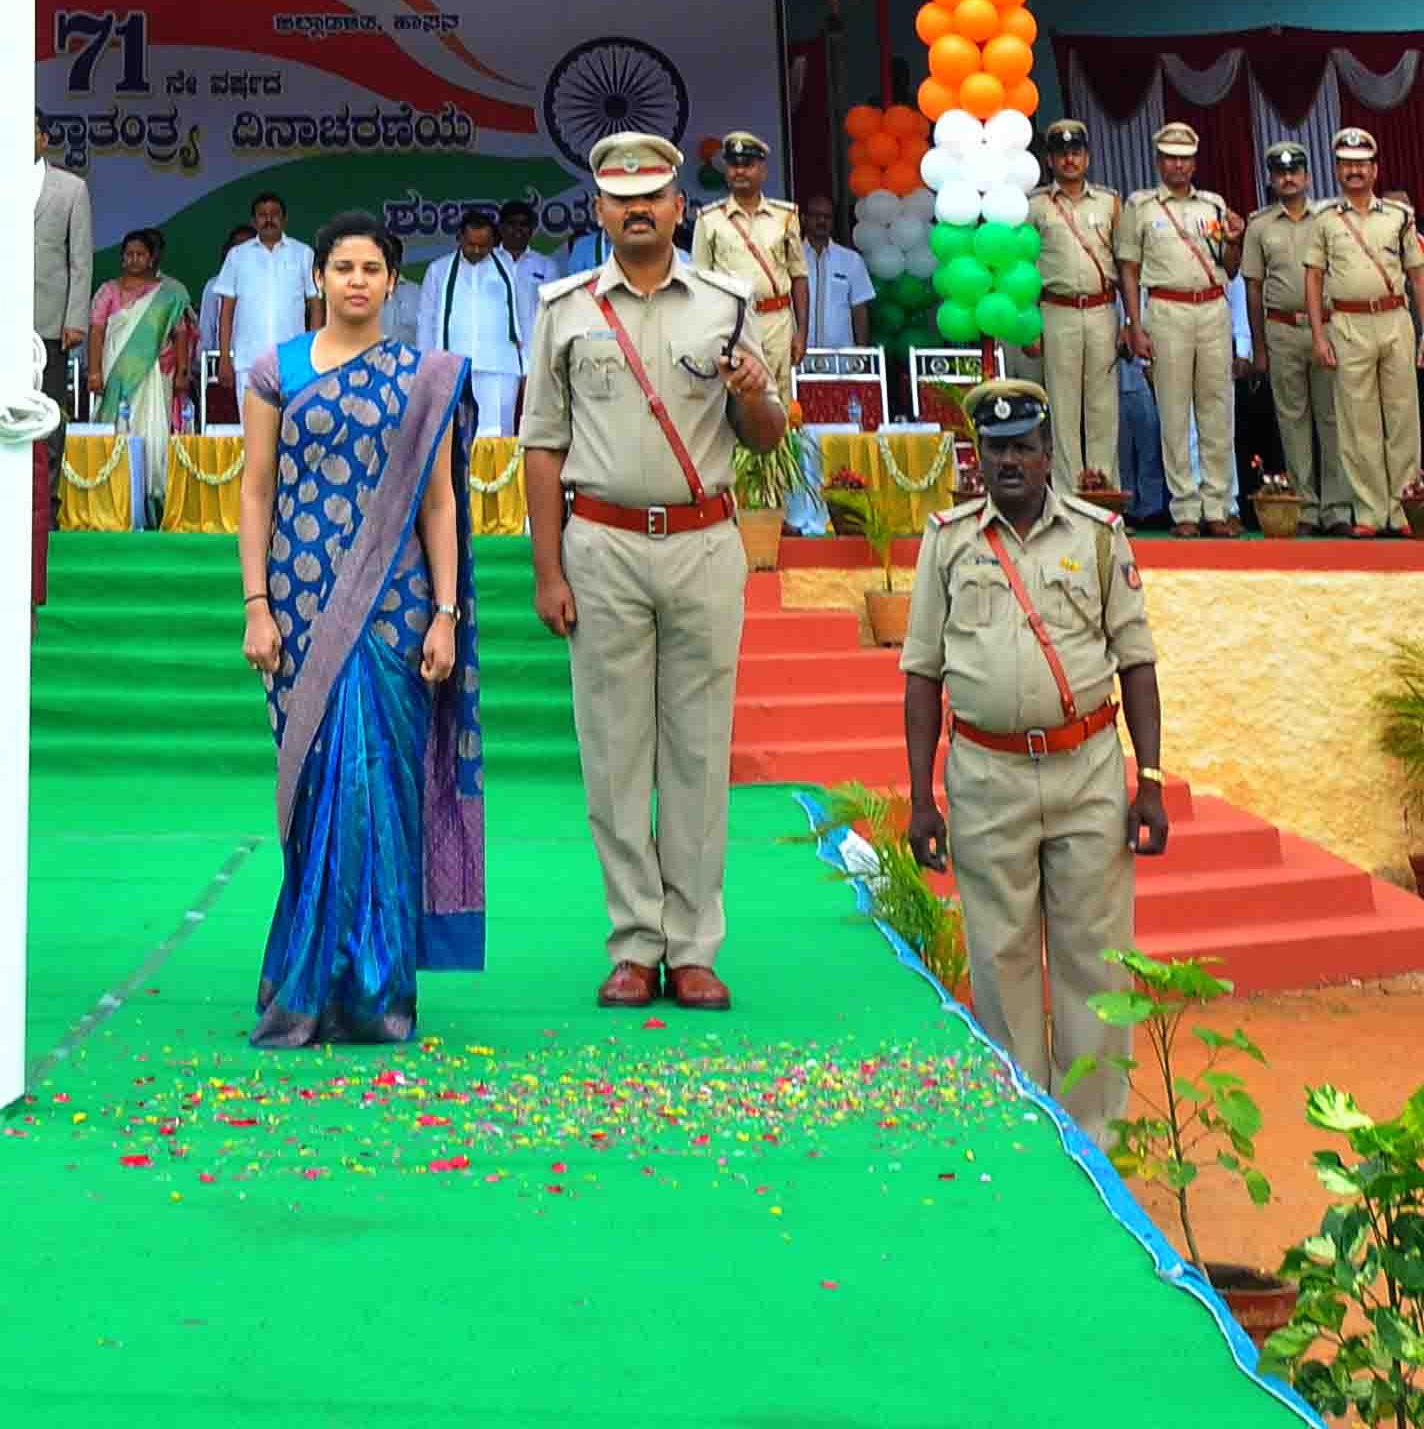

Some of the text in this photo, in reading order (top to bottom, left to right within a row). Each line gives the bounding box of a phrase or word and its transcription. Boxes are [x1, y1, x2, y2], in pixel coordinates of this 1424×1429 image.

[393, 13, 462, 33] ಹಾಸನ
[56, 10, 283, 99] 71 ನೇ ವರ್ಷದ
[231, 101, 473, 149] ದಿನಾಚರಣೆಯ
